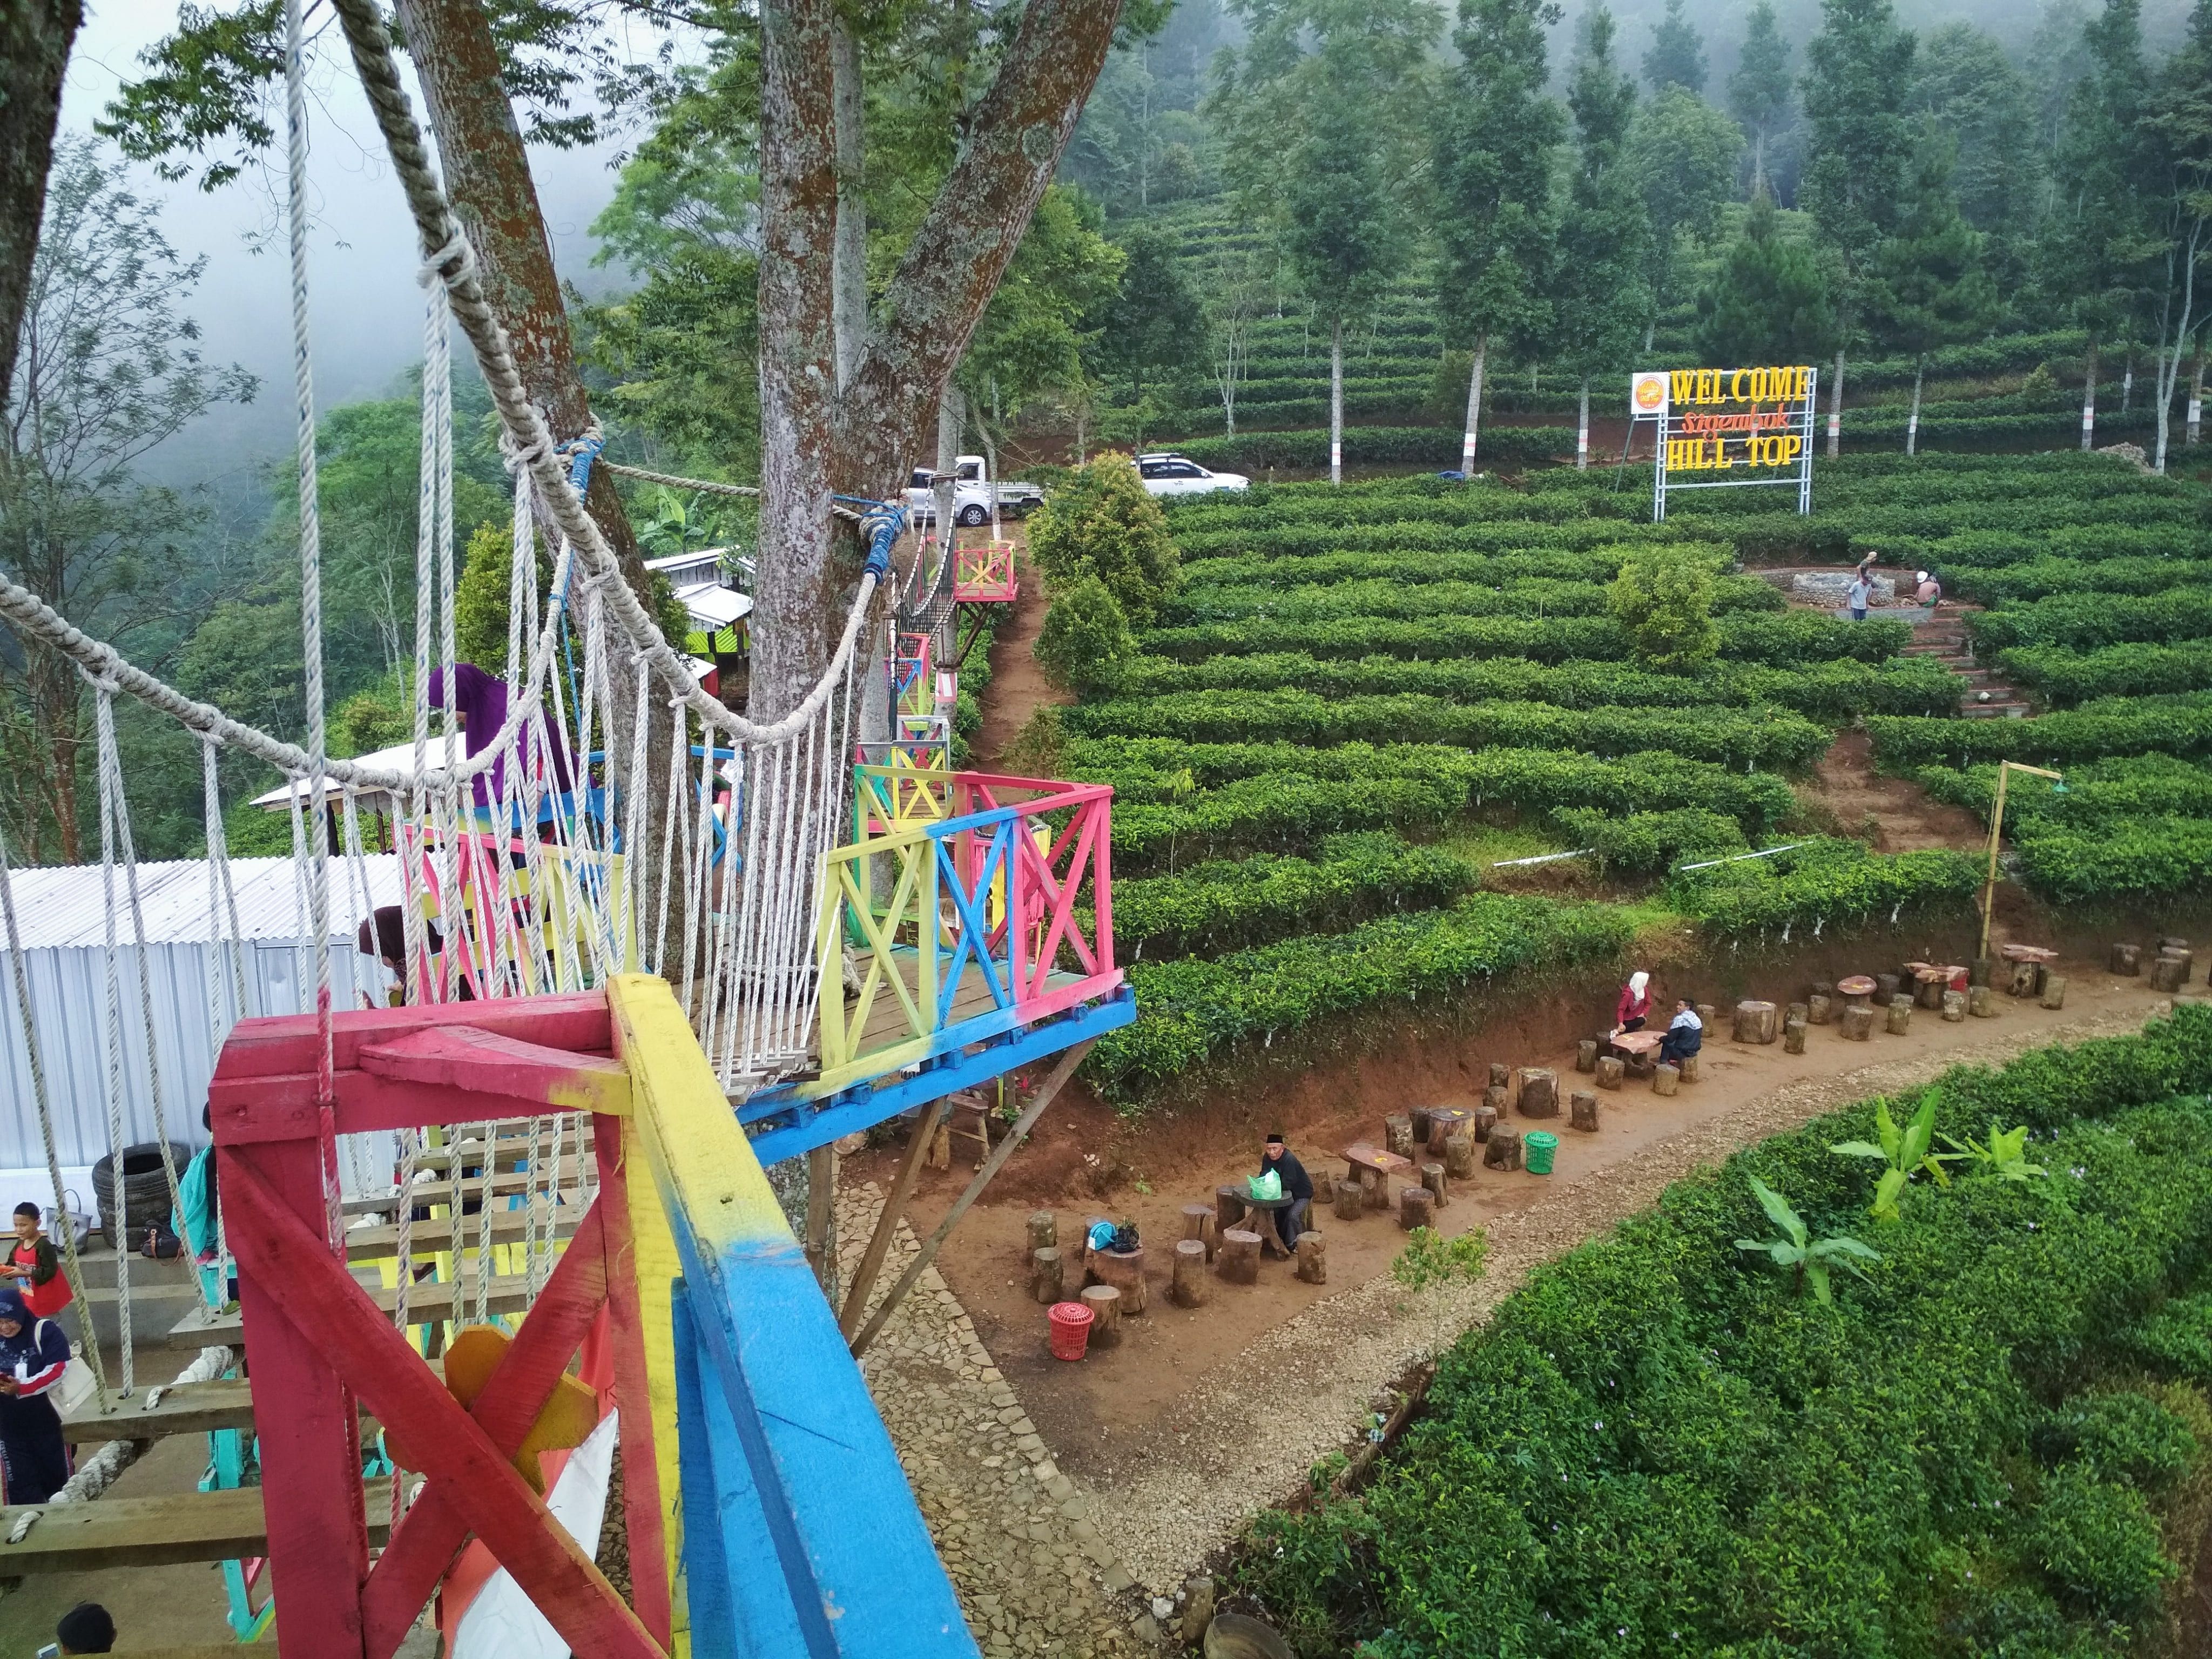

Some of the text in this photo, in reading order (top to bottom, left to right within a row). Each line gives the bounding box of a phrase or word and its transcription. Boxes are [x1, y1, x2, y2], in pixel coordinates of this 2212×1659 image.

[1682, 402, 1789, 443] Sigembok
[1666, 435, 1801, 471] HILL TOP
